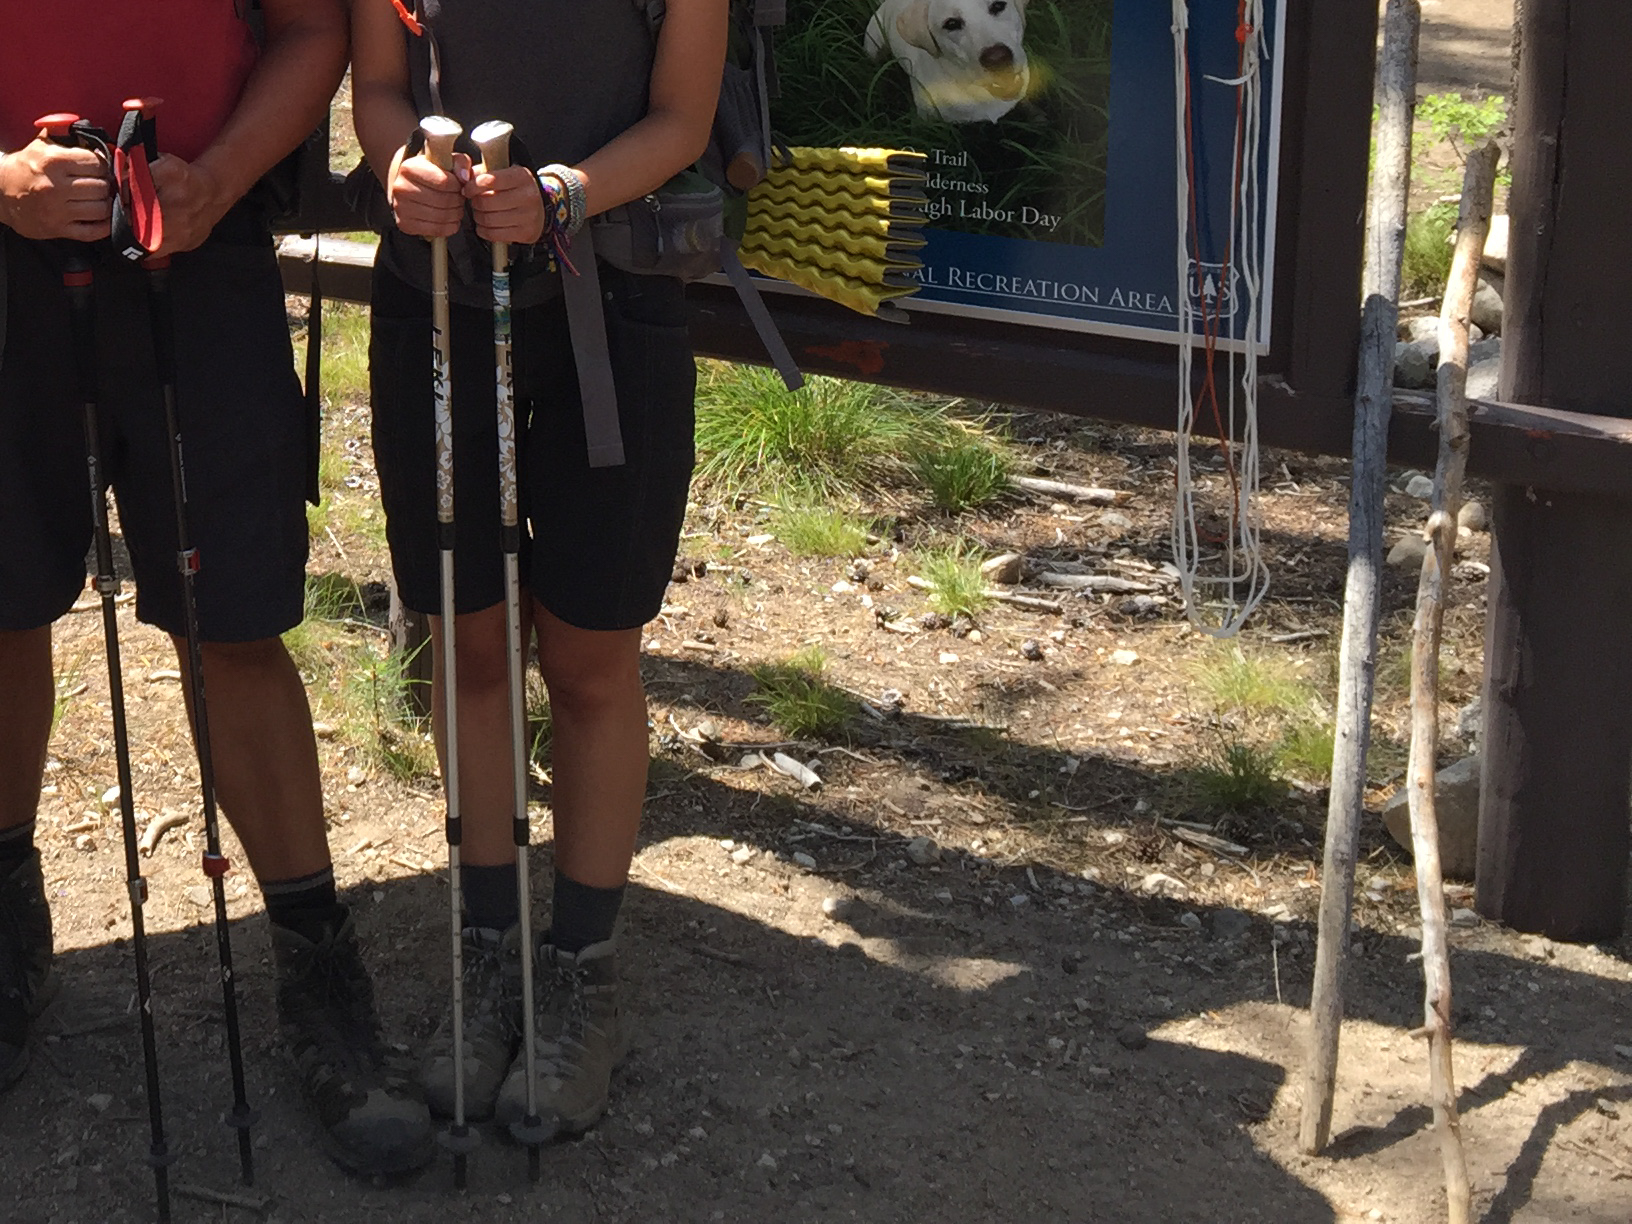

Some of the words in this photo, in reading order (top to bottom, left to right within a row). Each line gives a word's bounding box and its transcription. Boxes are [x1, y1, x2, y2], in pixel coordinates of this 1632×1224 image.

[931, 148, 969, 168] Trail
[926, 173, 990, 195] lderness
[960, 199, 1016, 223] Labor
[1021, 206, 1062, 233] Day
[949, 266, 1100, 303] RECREATION
[1108, 286, 1174, 314] AREA
